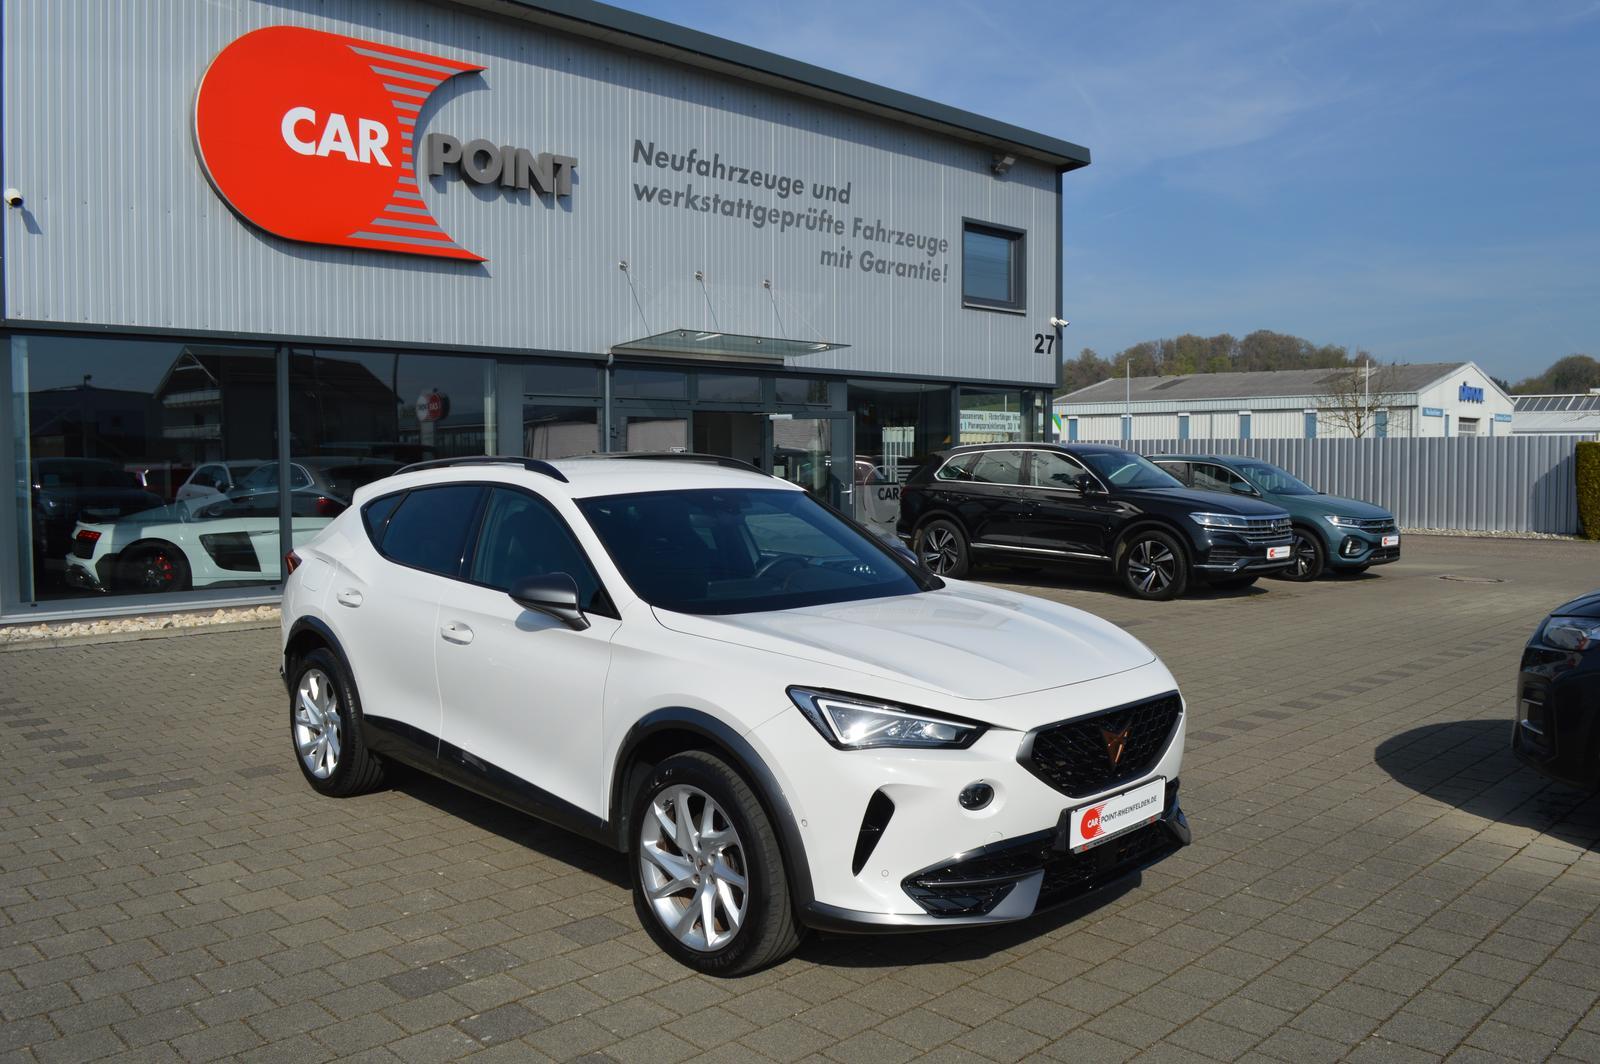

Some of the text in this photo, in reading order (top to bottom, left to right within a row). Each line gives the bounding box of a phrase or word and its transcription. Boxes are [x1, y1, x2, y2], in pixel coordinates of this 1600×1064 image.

[281, 106, 577, 196] CAR POINT
[632, 139, 852, 205] Neufahrzeuge und
[633, 181, 949, 255] werkstattgeprüfte Fahrzeuge
[820, 245, 948, 284] mit Garantie!
[1034, 333, 1055, 355] 27
[878, 487, 900, 501] CAR
[1087, 818, 1099, 829] CAR
